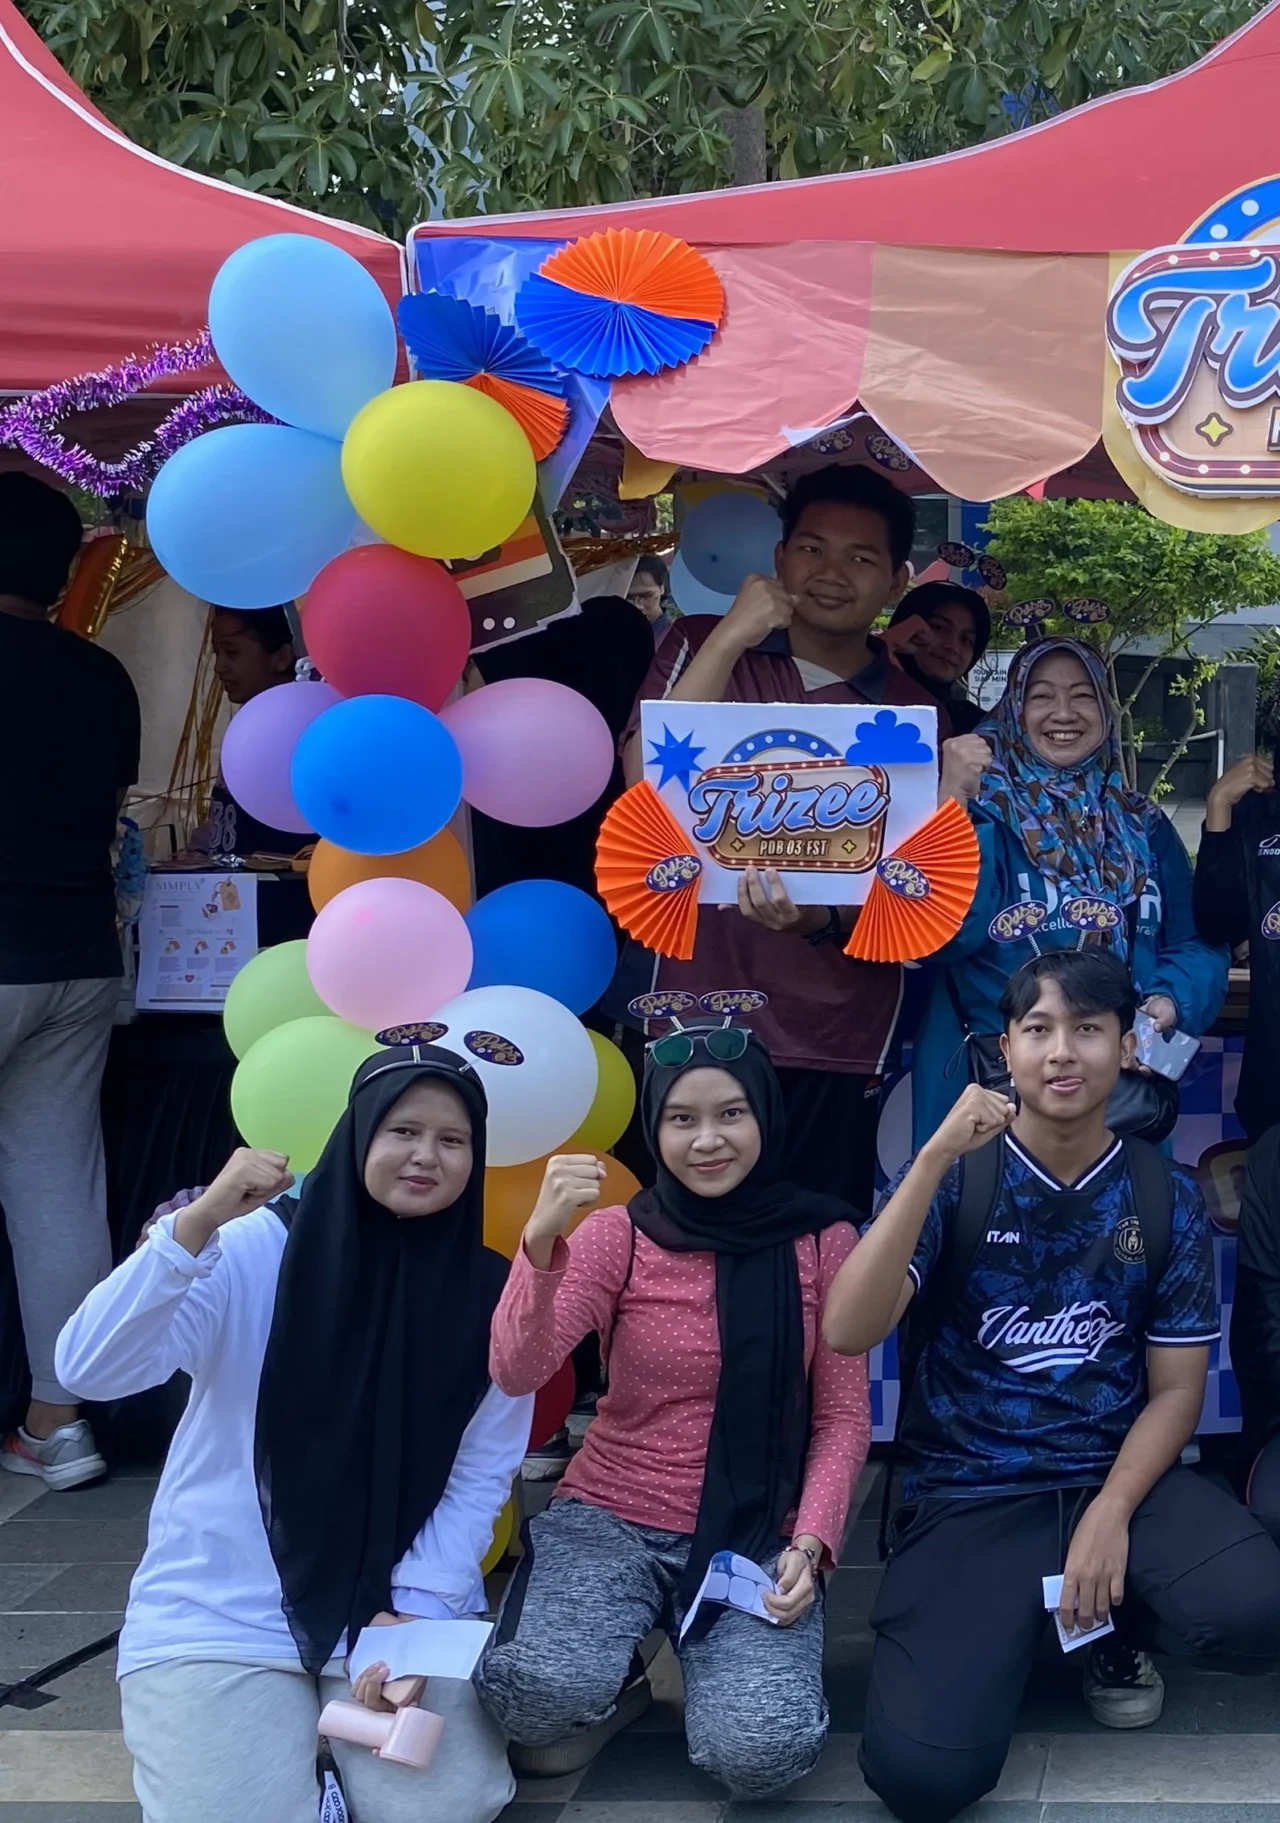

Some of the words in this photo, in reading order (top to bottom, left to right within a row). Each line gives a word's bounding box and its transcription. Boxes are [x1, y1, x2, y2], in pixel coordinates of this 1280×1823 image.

[690, 773, 890, 842] Trizee
[759, 838, 784, 856] PDB
[786, 837, 804, 856] 03
[806, 838, 829, 857] FST
